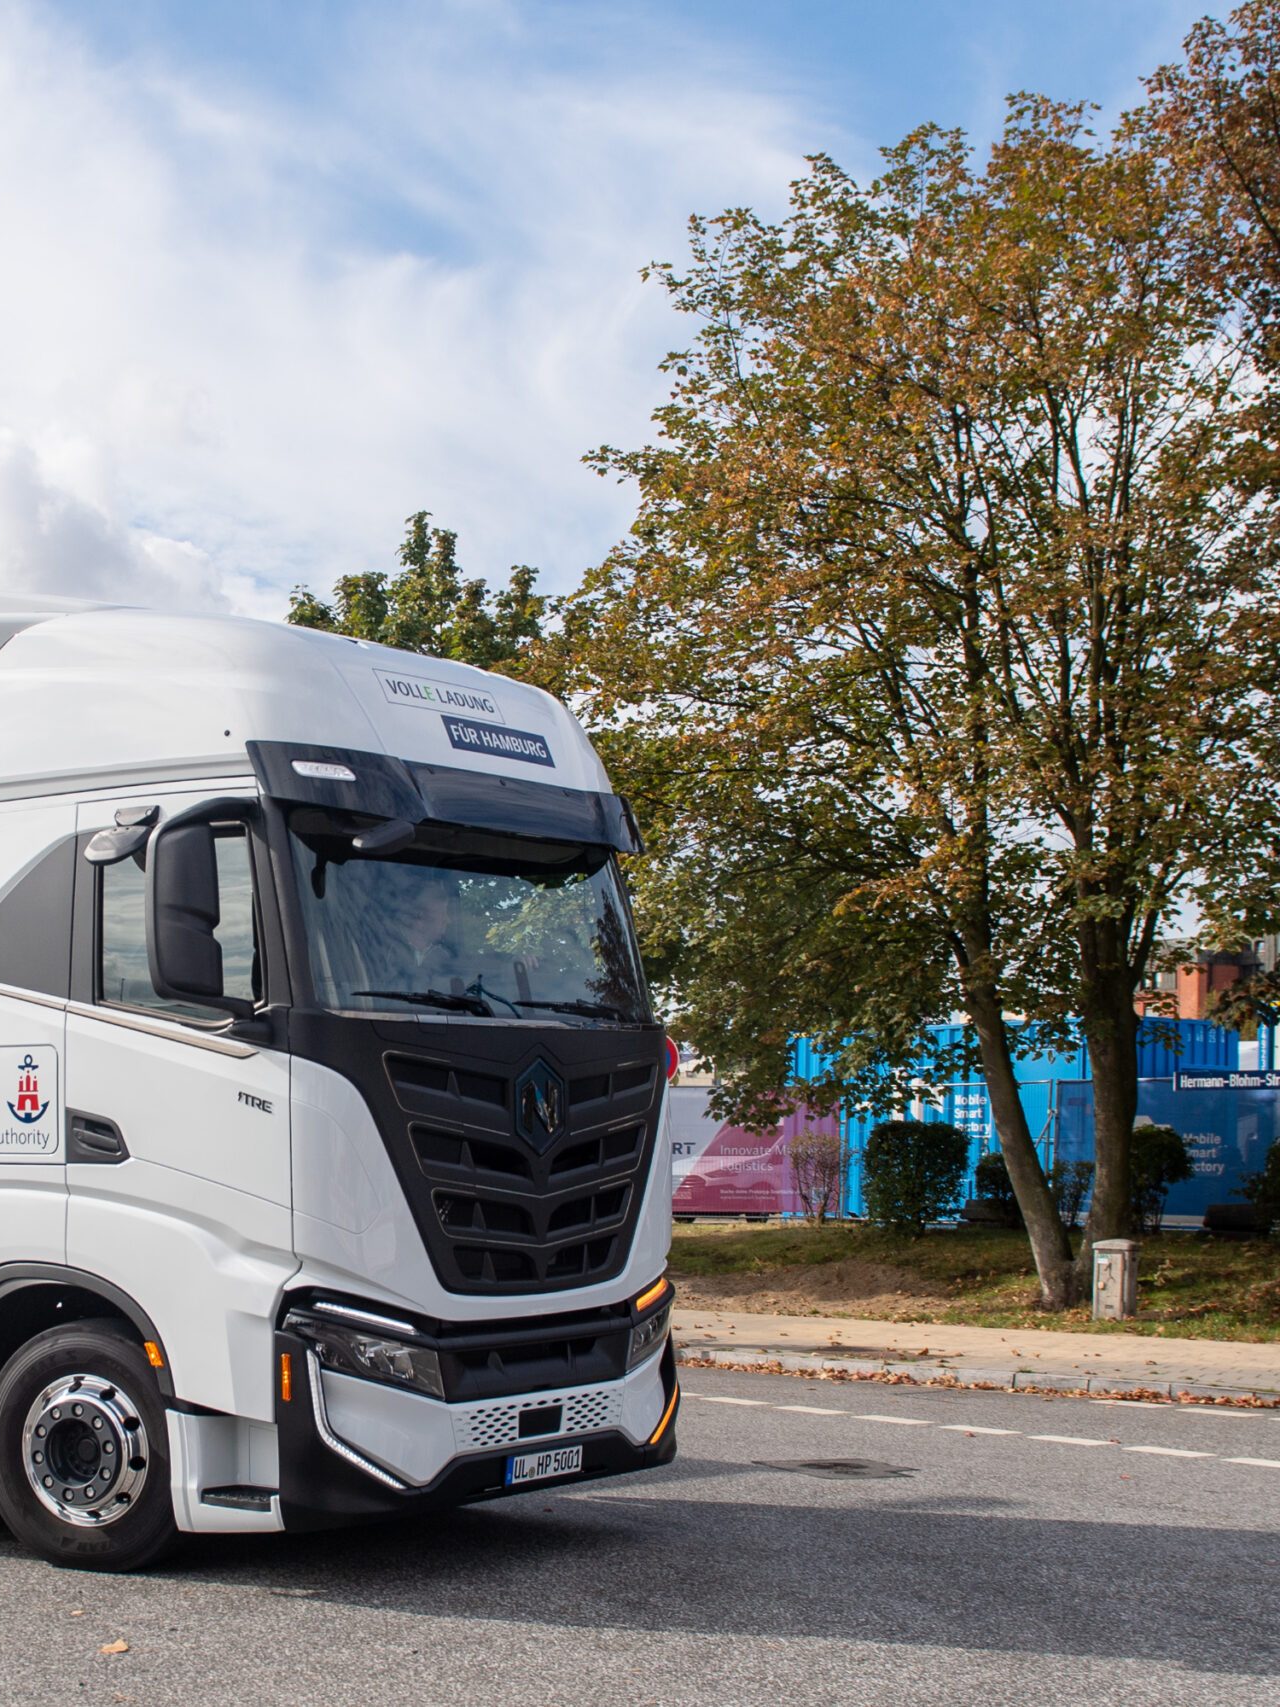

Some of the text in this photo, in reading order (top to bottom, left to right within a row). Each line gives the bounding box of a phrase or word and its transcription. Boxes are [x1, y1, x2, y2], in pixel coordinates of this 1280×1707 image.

[385, 678, 495, 713] VOLLE LADUNG
[450, 723, 547, 758] FÜR HAMBURG
[954, 1094, 987, 1105] Mobile
[954, 1108, 982, 1119] Smart
[720, 1144, 772, 1156] Innovate
[720, 1160, 774, 1173] Logistics
[514, 1448, 581, 1479] UL HP 5001
